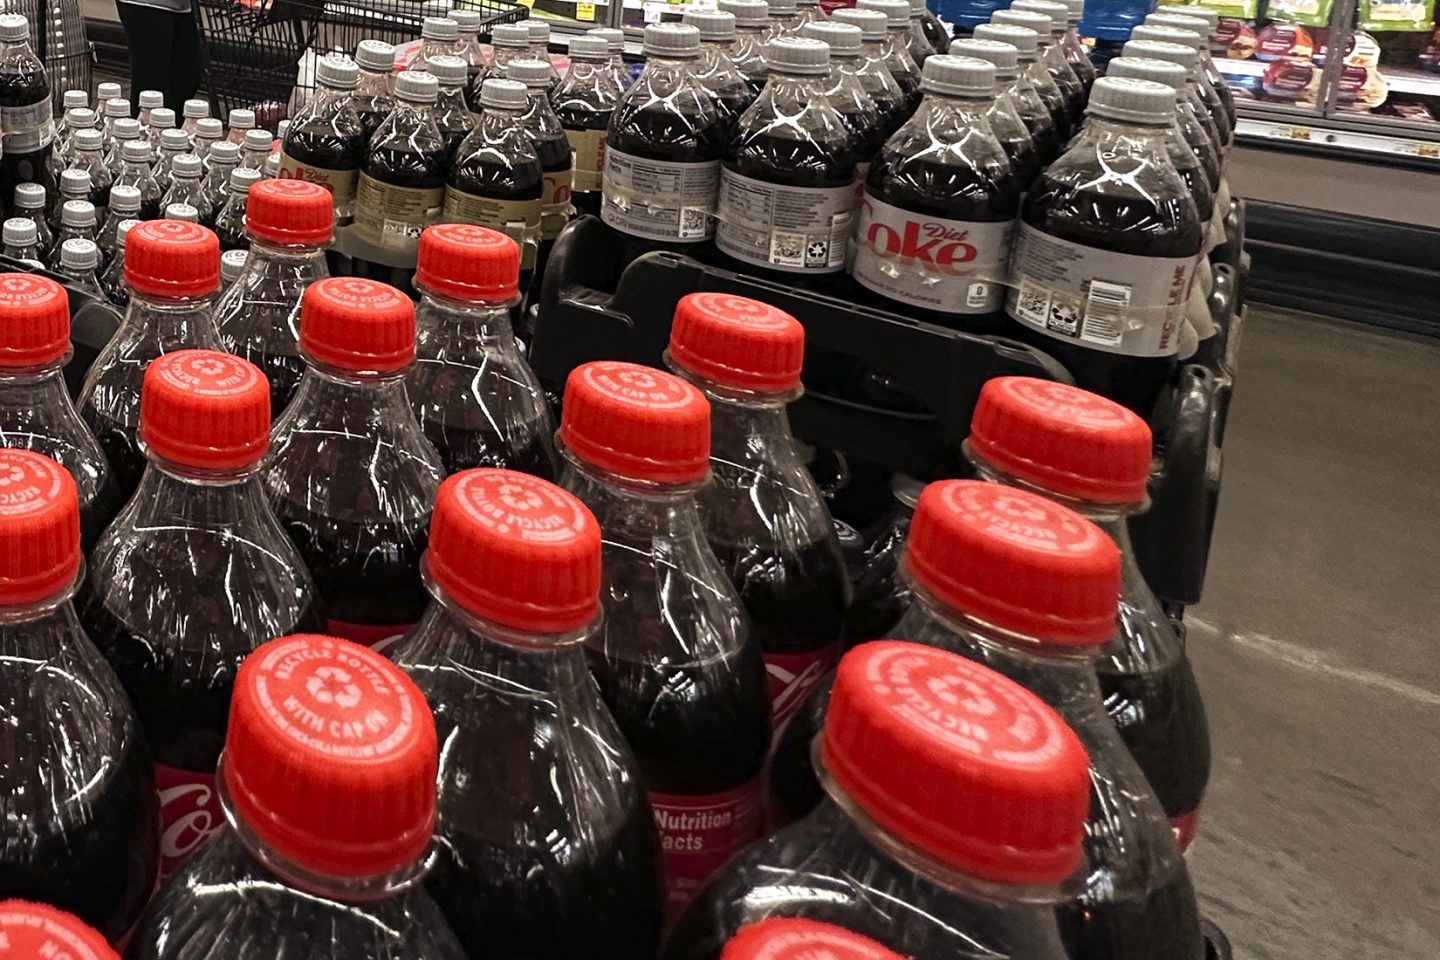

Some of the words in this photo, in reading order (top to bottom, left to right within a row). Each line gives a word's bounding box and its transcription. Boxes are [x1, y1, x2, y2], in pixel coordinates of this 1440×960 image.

[861, 199, 977, 277] oke
[923, 222, 968, 241] Diet
[1171, 264, 1185, 287] ME
[621, 387, 646, 399] CAP
[505, 512, 566, 530] RECYCLE
[274, 649, 332, 681] RECYCLE
[336, 652, 391, 696] BOTTLE
[283, 695, 326, 732] WITH
[329, 720, 364, 739] CAP
[364, 709, 389, 733] ON
[654, 809, 731, 830] Nutrition
